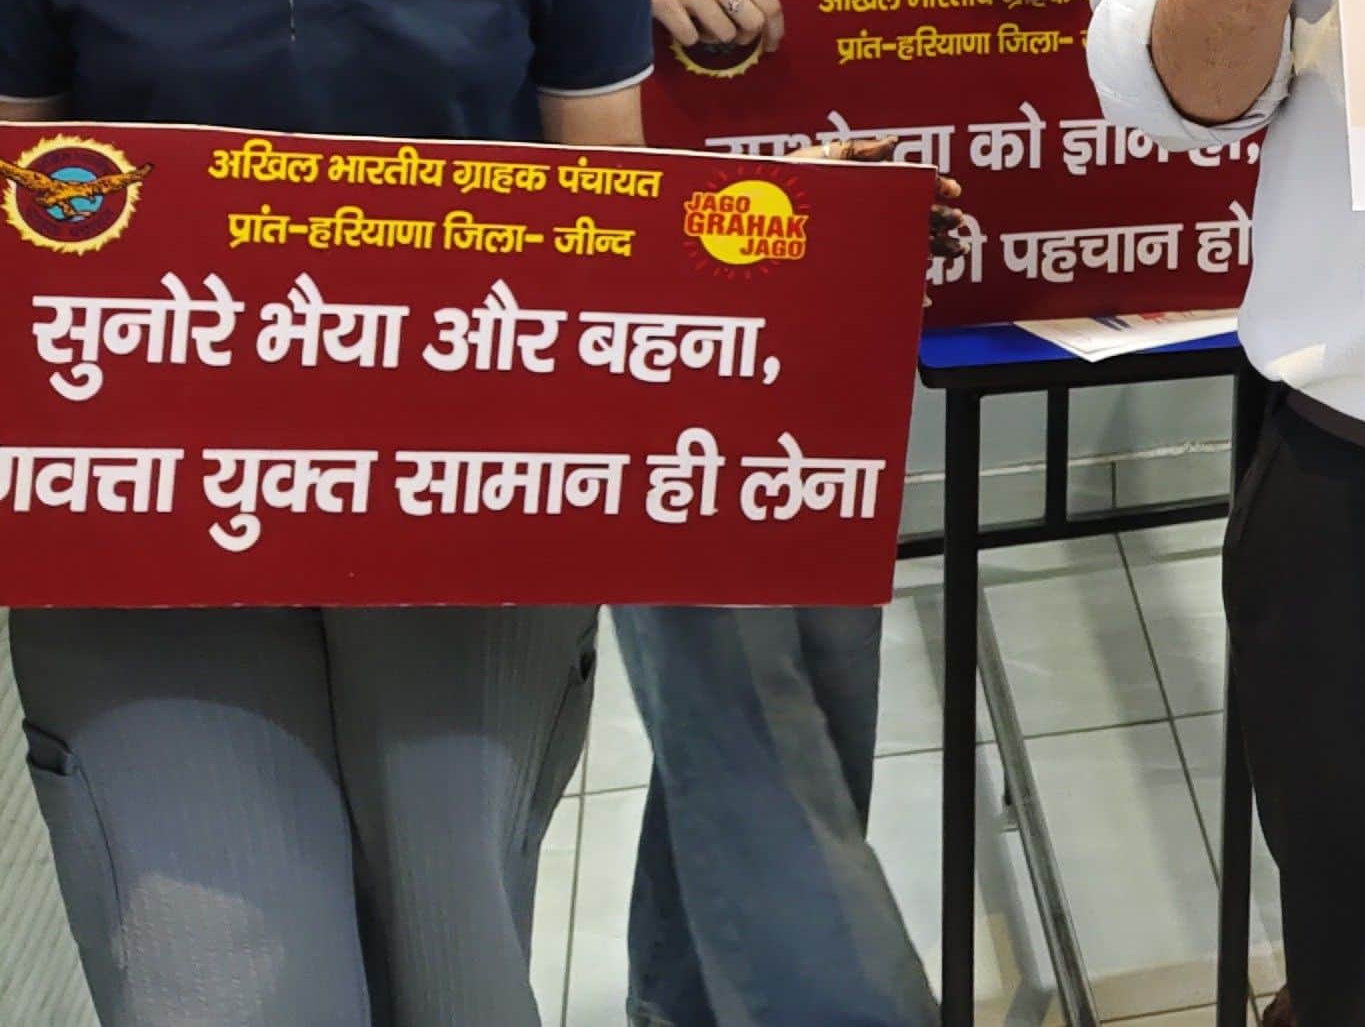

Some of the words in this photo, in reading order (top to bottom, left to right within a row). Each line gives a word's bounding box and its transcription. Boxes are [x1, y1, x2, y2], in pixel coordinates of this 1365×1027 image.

[836, 24, 992, 65] प्रांत-हरियाणा
[968, 101, 1046, 170] को
[207, 138, 324, 183] अखिल
[327, 145, 447, 187] भारतीय
[452, 160, 551, 194] ग्राहक
[557, 156, 663, 198] पंचायत
[227, 203, 436, 249] प्रांत-हरियाणा
[442, 210, 545, 253] जिला-
[553, 215, 636, 257] जीन्द
[684, 191, 750, 215] JAGO
[684, 211, 806, 239] GRAHAK
[739, 236, 806, 261] JAGO
[1000, 223, 1183, 283] पहचान
[32, 272, 245, 401] सुनोरे
[256, 272, 410, 368] भैया
[422, 279, 568, 373] और
[578, 311, 780, 385] बहना,
[202, 449, 379, 552] युक्त
[395, 451, 631, 516] सामान
[646, 427, 726, 523] ही
[740, 432, 886, 521] लेना
